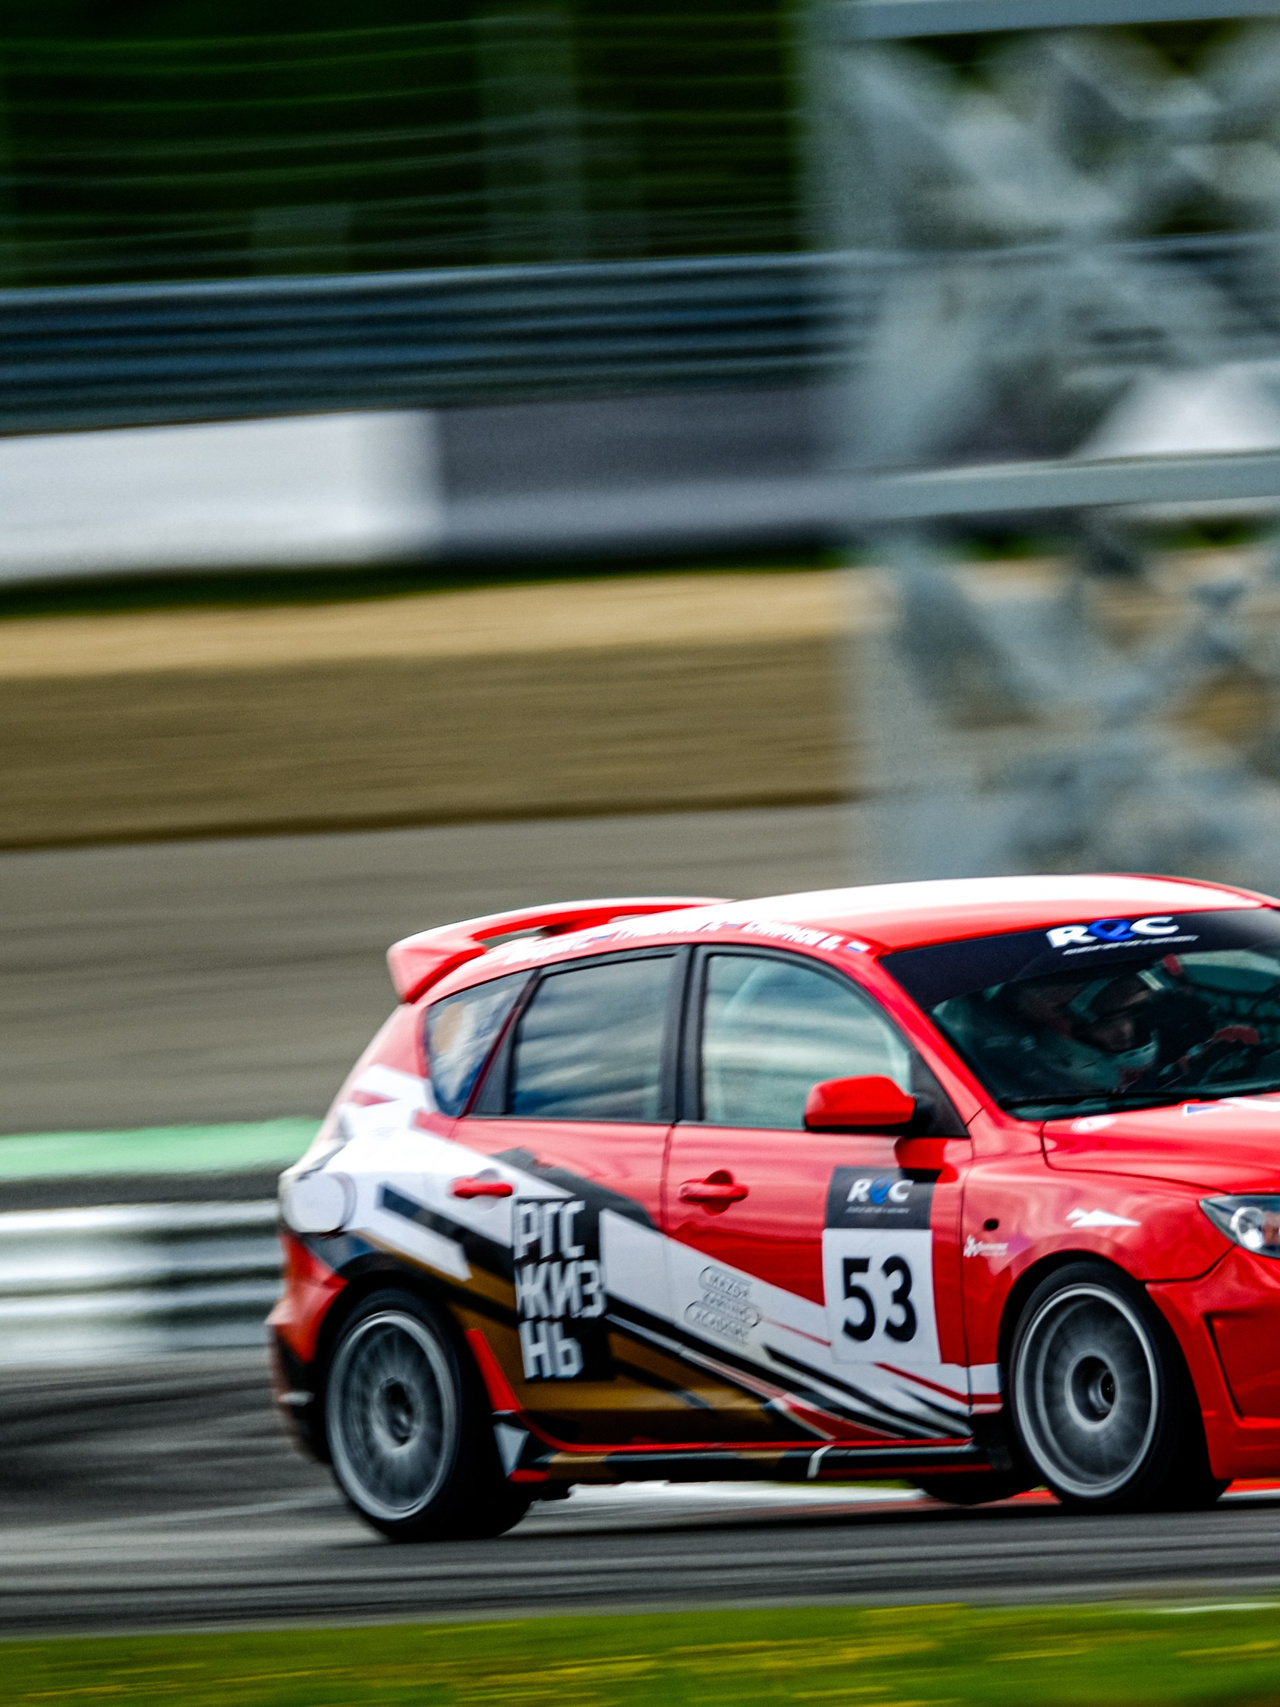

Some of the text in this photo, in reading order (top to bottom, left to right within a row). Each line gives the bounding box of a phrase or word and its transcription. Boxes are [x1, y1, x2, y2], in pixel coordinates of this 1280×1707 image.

[513, 1200, 586, 1260] РГС
[513, 1259, 608, 1320] ЖИЗ
[842, 1255, 917, 1343] 53
[518, 1319, 585, 1380] НЬ
